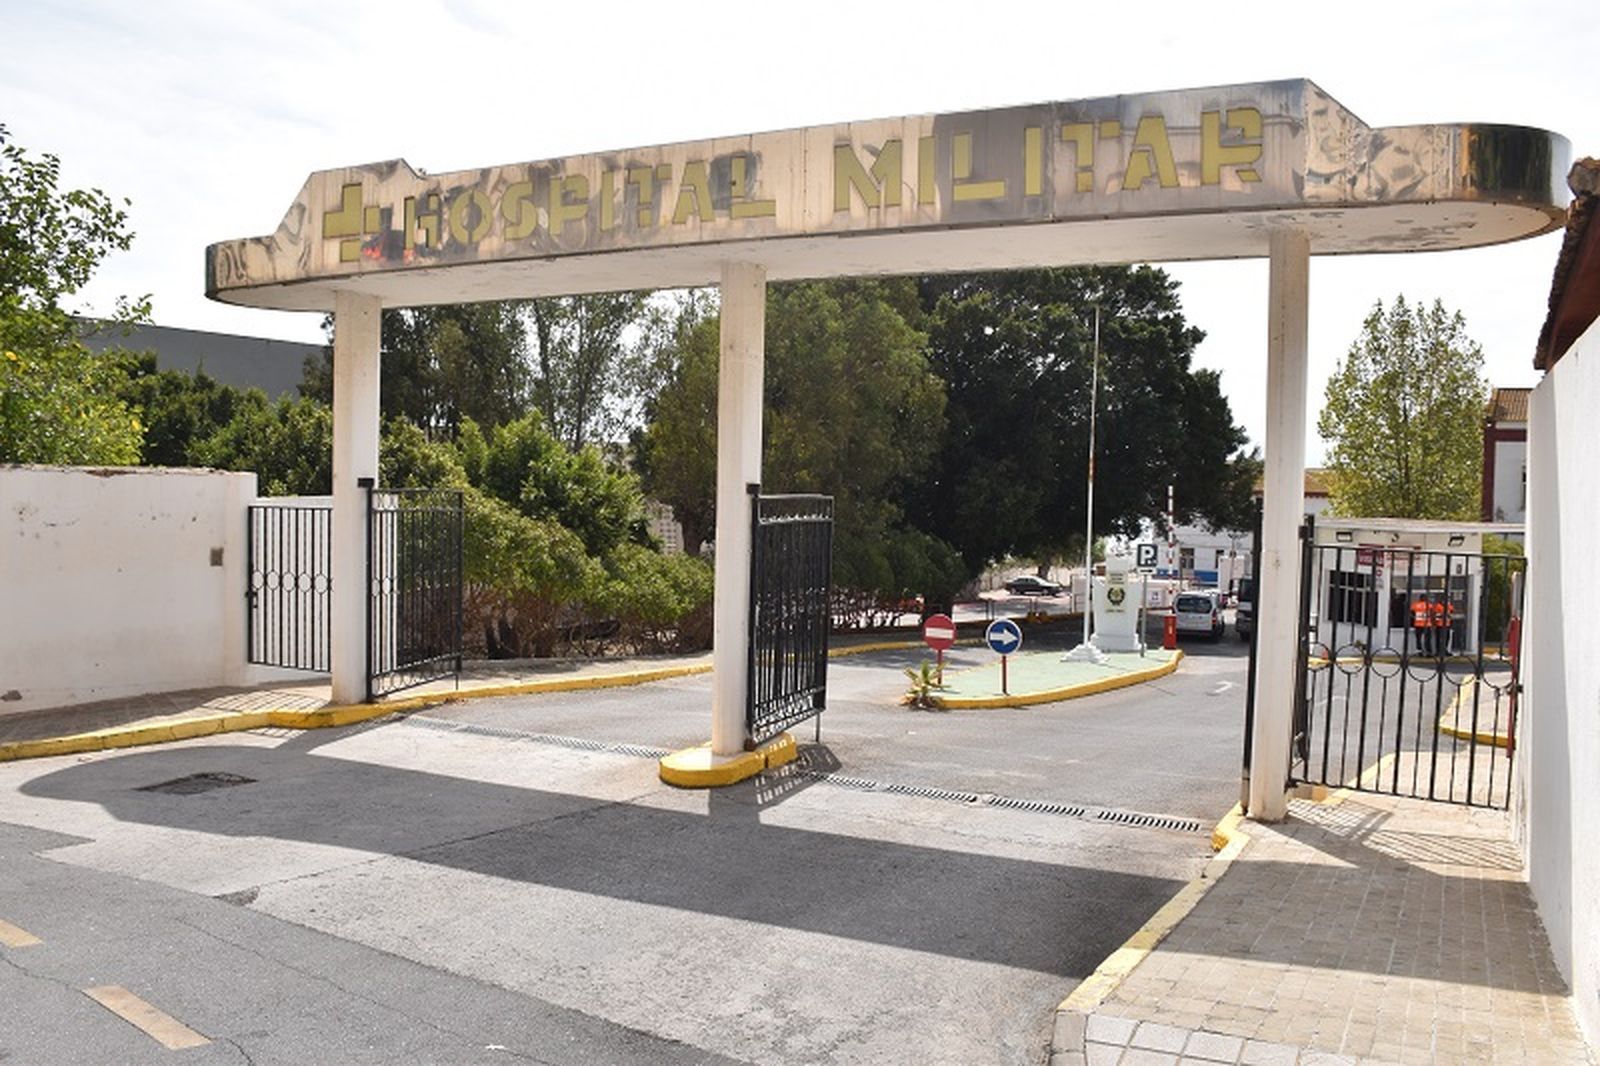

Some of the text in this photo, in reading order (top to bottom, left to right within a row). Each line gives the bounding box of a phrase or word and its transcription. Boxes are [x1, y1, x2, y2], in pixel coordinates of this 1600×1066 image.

[404, 107, 1264, 250] HOSPITAL MILITAR
[1140, 545, 1155, 566] P
